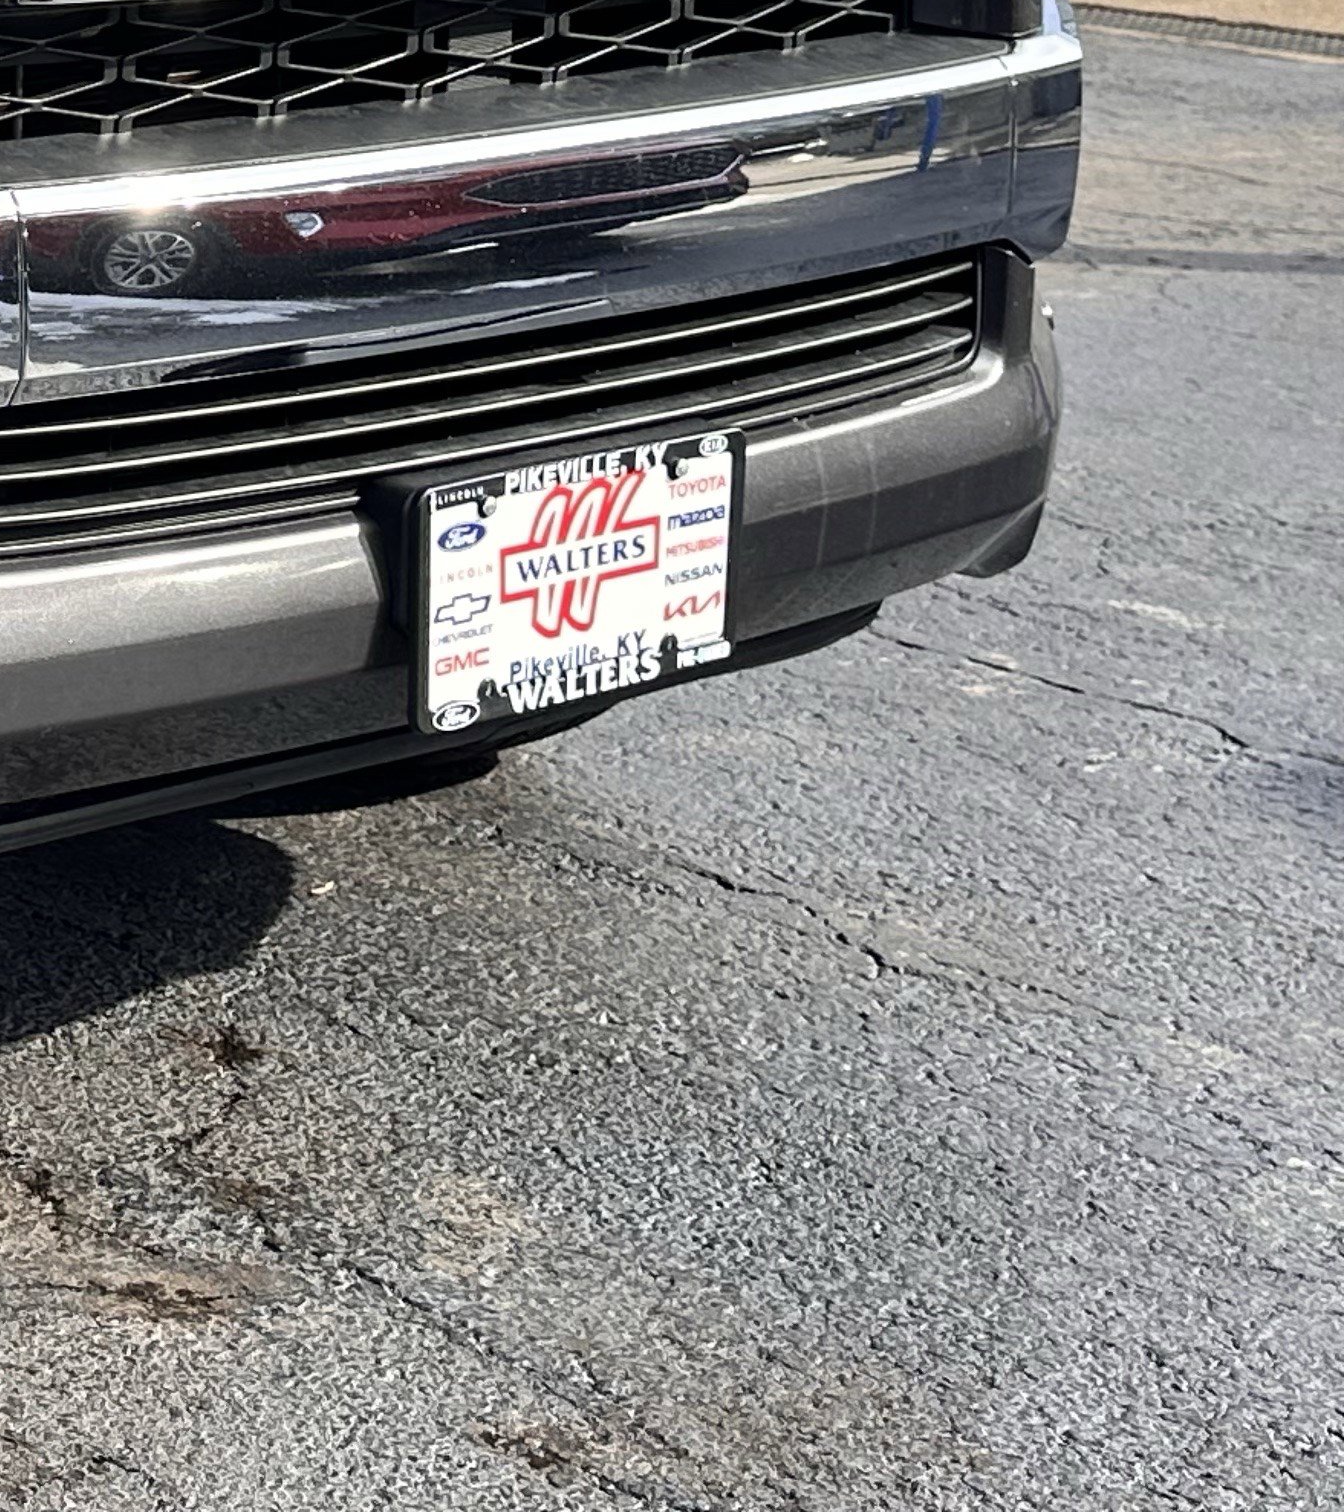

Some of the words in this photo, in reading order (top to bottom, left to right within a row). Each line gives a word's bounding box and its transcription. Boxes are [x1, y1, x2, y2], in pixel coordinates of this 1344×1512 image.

[668, 475, 727, 500] TOYOTA
[516, 534, 646, 582] WALTERS
[439, 563, 494, 584] INCOLN
[664, 563, 724, 587] NISSAN
[616, 629, 647, 658] KY
[435, 647, 491, 676] GMC
[507, 649, 663, 714] WALTERS
